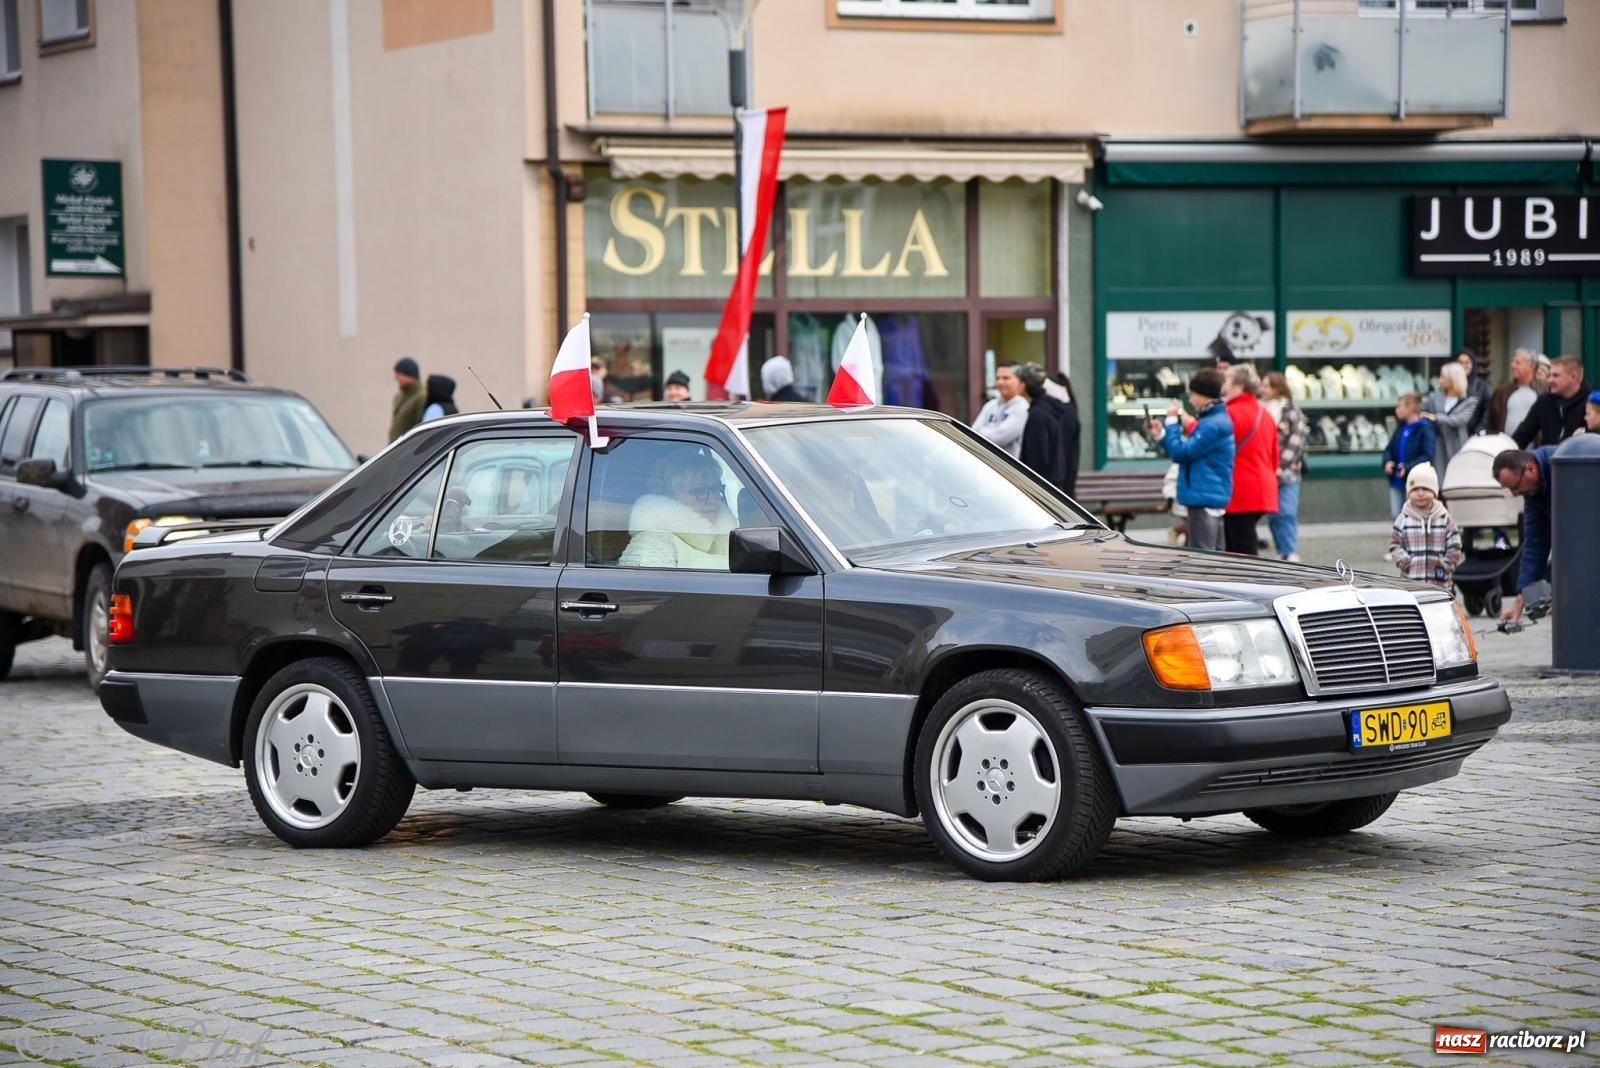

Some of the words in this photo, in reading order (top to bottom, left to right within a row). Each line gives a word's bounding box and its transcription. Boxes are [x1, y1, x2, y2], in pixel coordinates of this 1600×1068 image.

[1493, 249, 1546, 266] 1989
[1138, 316, 1180, 332] Pierre
[1143, 326, 1192, 353] Ricaud
[1365, 712, 1402, 743] SWD
[1408, 709, 1428, 739] 90
[1353, 733, 1361, 742] PL
